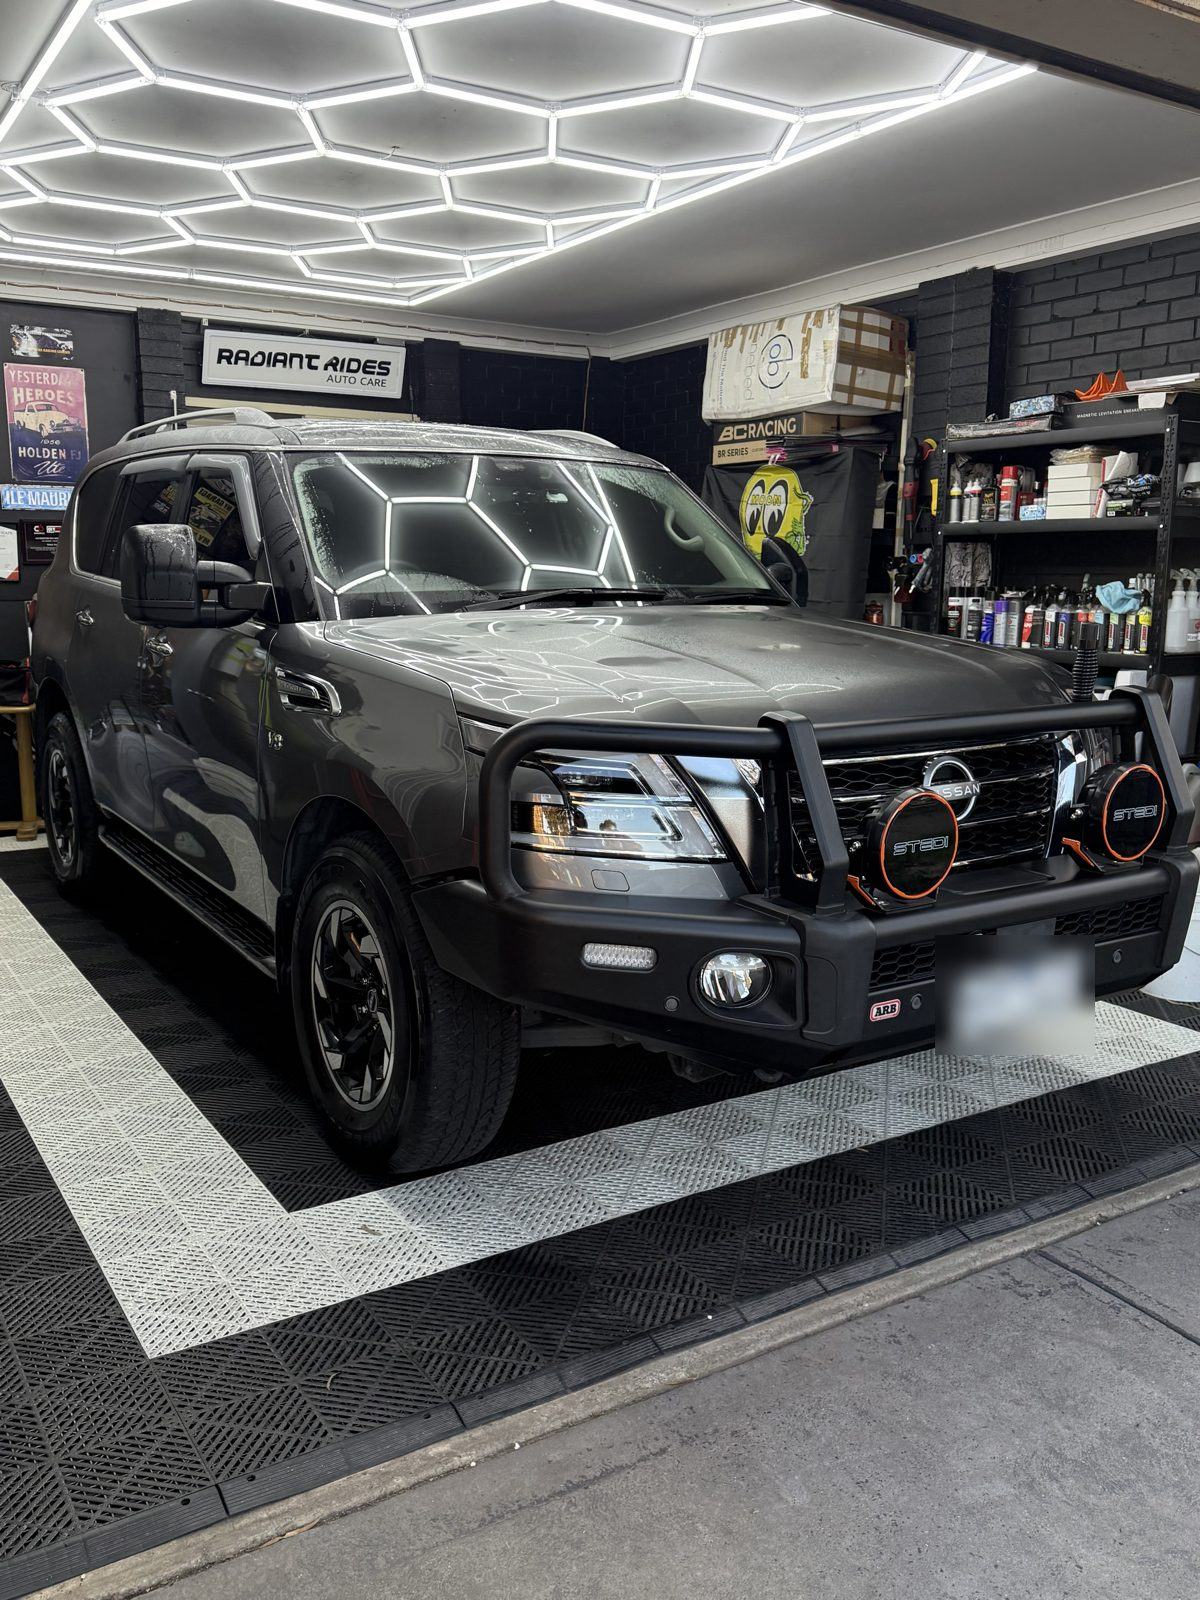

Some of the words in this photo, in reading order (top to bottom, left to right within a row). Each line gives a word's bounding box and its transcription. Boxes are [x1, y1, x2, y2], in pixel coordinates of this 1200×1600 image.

[216, 347, 321, 371] RADIANT
[323, 355, 392, 376] RIDES
[326, 374, 357, 385] AUTO
[360, 377, 387, 388] CARE
[13, 386, 76, 407] HEROES
[748, 417, 797, 439] RACING
[18, 446, 67, 460] HOLDEN
[717, 449, 726, 458] BR
[727, 447, 749, 457] SERIES
[750, 493, 782, 506] MOON
[936, 783, 980, 799] SSAN
[1113, 804, 1158, 822] STEDI
[893, 835, 949, 856] STEDI
[874, 1003, 897, 1018] ARB
